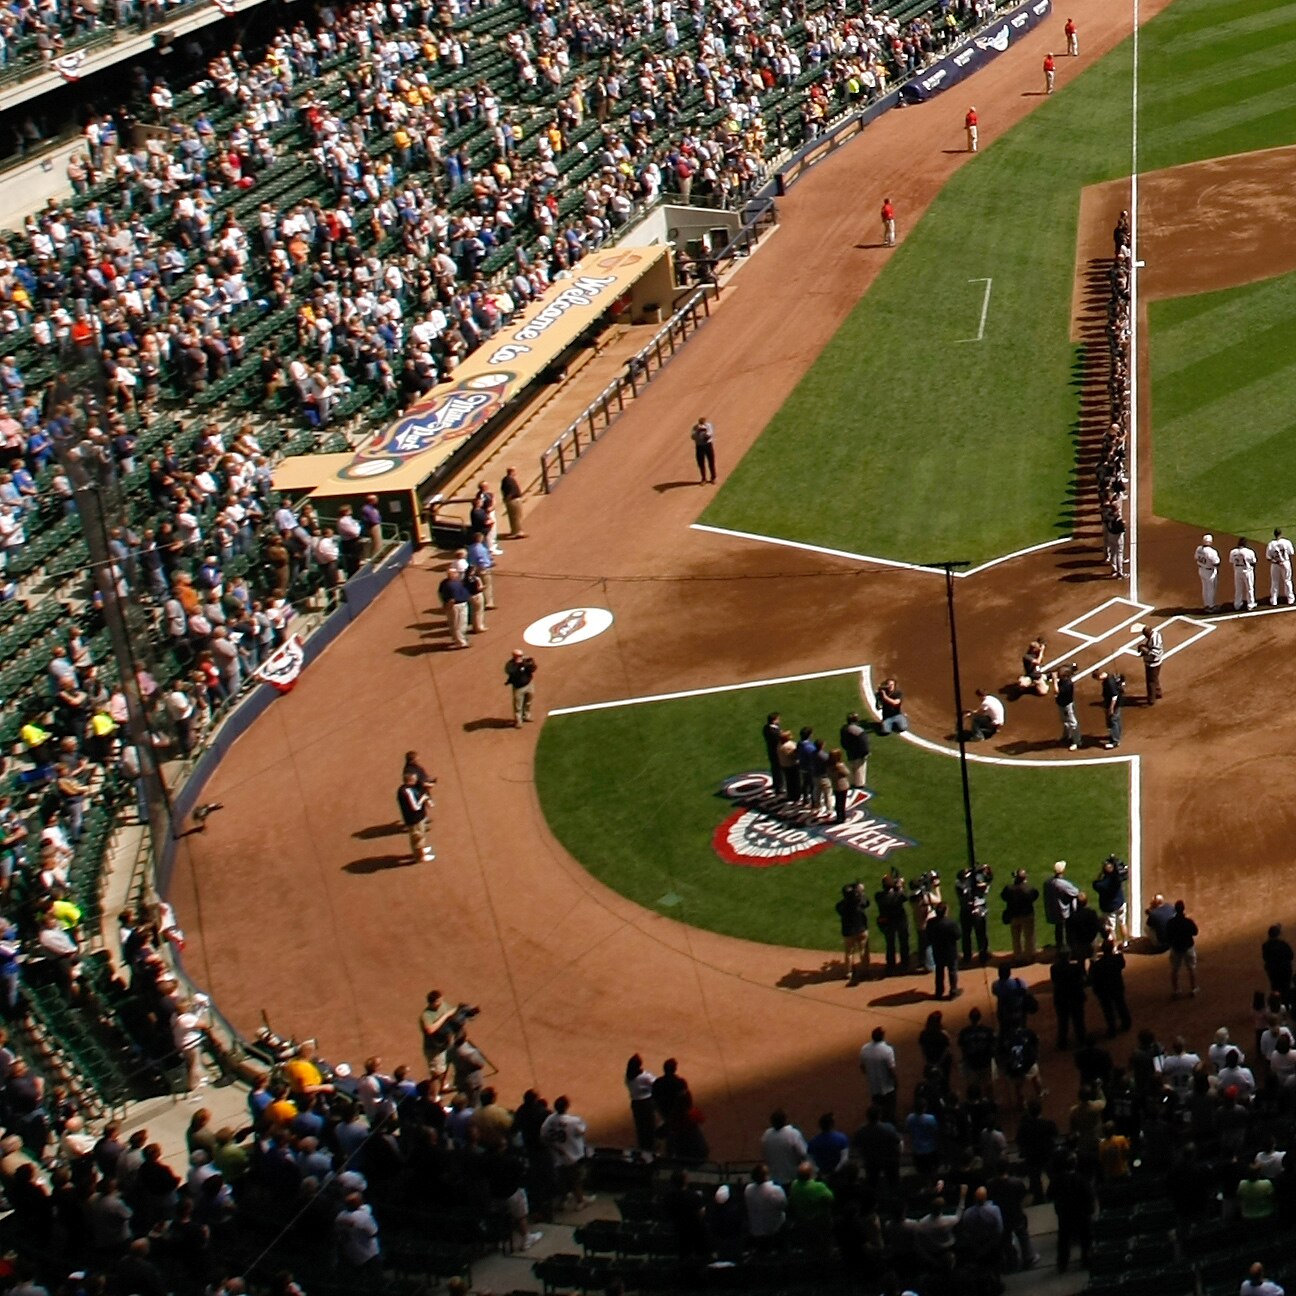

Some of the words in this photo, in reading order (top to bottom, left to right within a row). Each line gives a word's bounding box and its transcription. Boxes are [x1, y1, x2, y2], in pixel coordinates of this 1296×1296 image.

[512, 274, 618, 342] Welcome
[487, 343, 532, 366] to
[824, 809, 908, 857] WEEK
